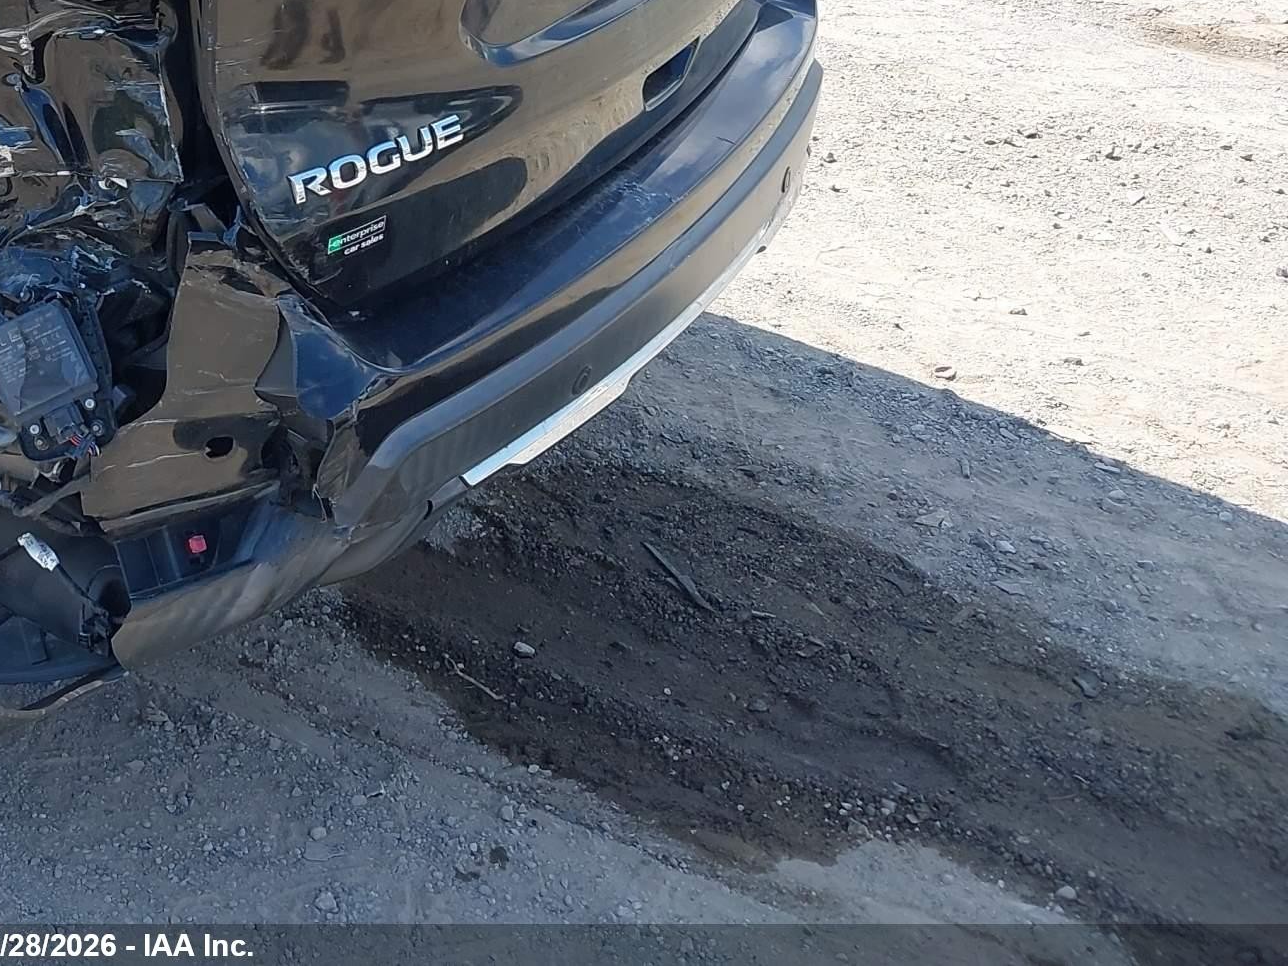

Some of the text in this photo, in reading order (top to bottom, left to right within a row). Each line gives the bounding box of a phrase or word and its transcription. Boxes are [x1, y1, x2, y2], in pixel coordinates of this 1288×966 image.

[287, 114, 464, 204] ROGUE
[330, 221, 385, 247] enterprise
[344, 233, 385, 256] car sales
